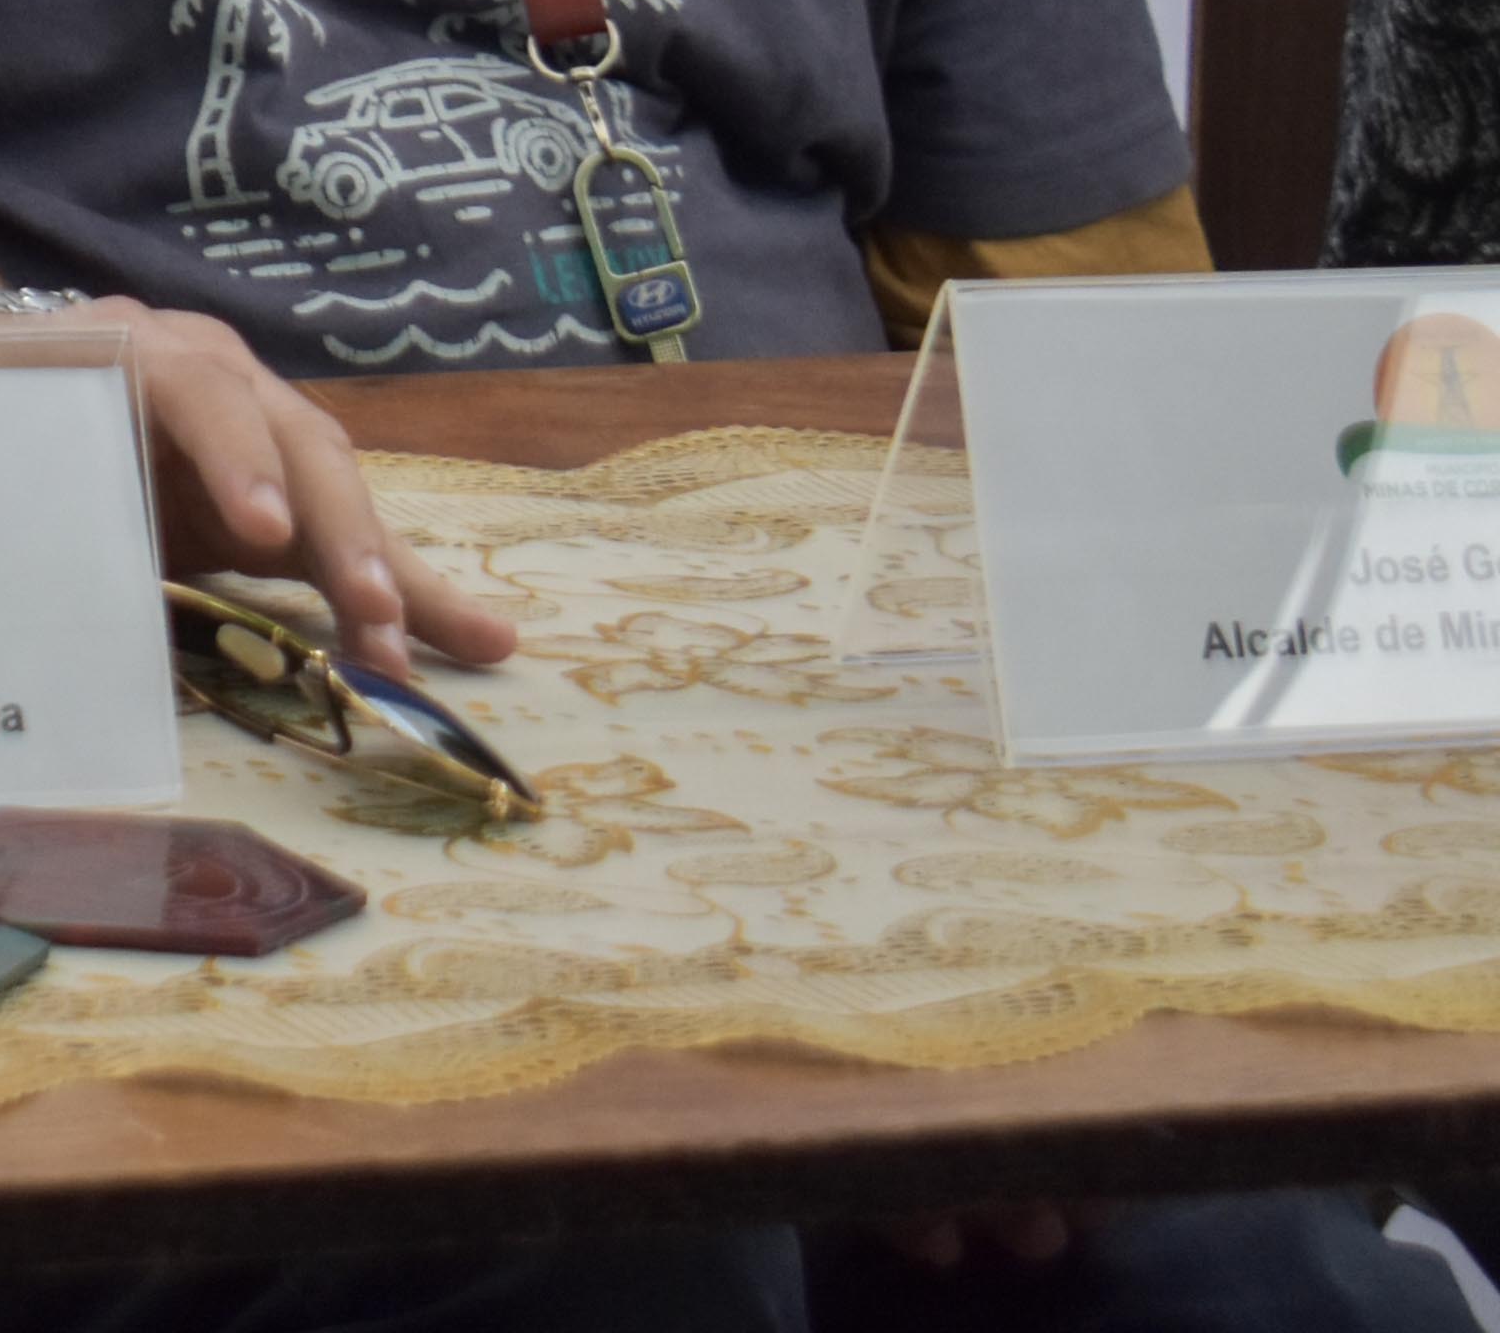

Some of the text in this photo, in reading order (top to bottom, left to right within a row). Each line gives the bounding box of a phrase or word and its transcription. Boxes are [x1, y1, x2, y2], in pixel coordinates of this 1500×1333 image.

[1351, 543, 1450, 585] José
[1202, 616, 1361, 660] Alcalde
[1376, 613, 1425, 652] de
